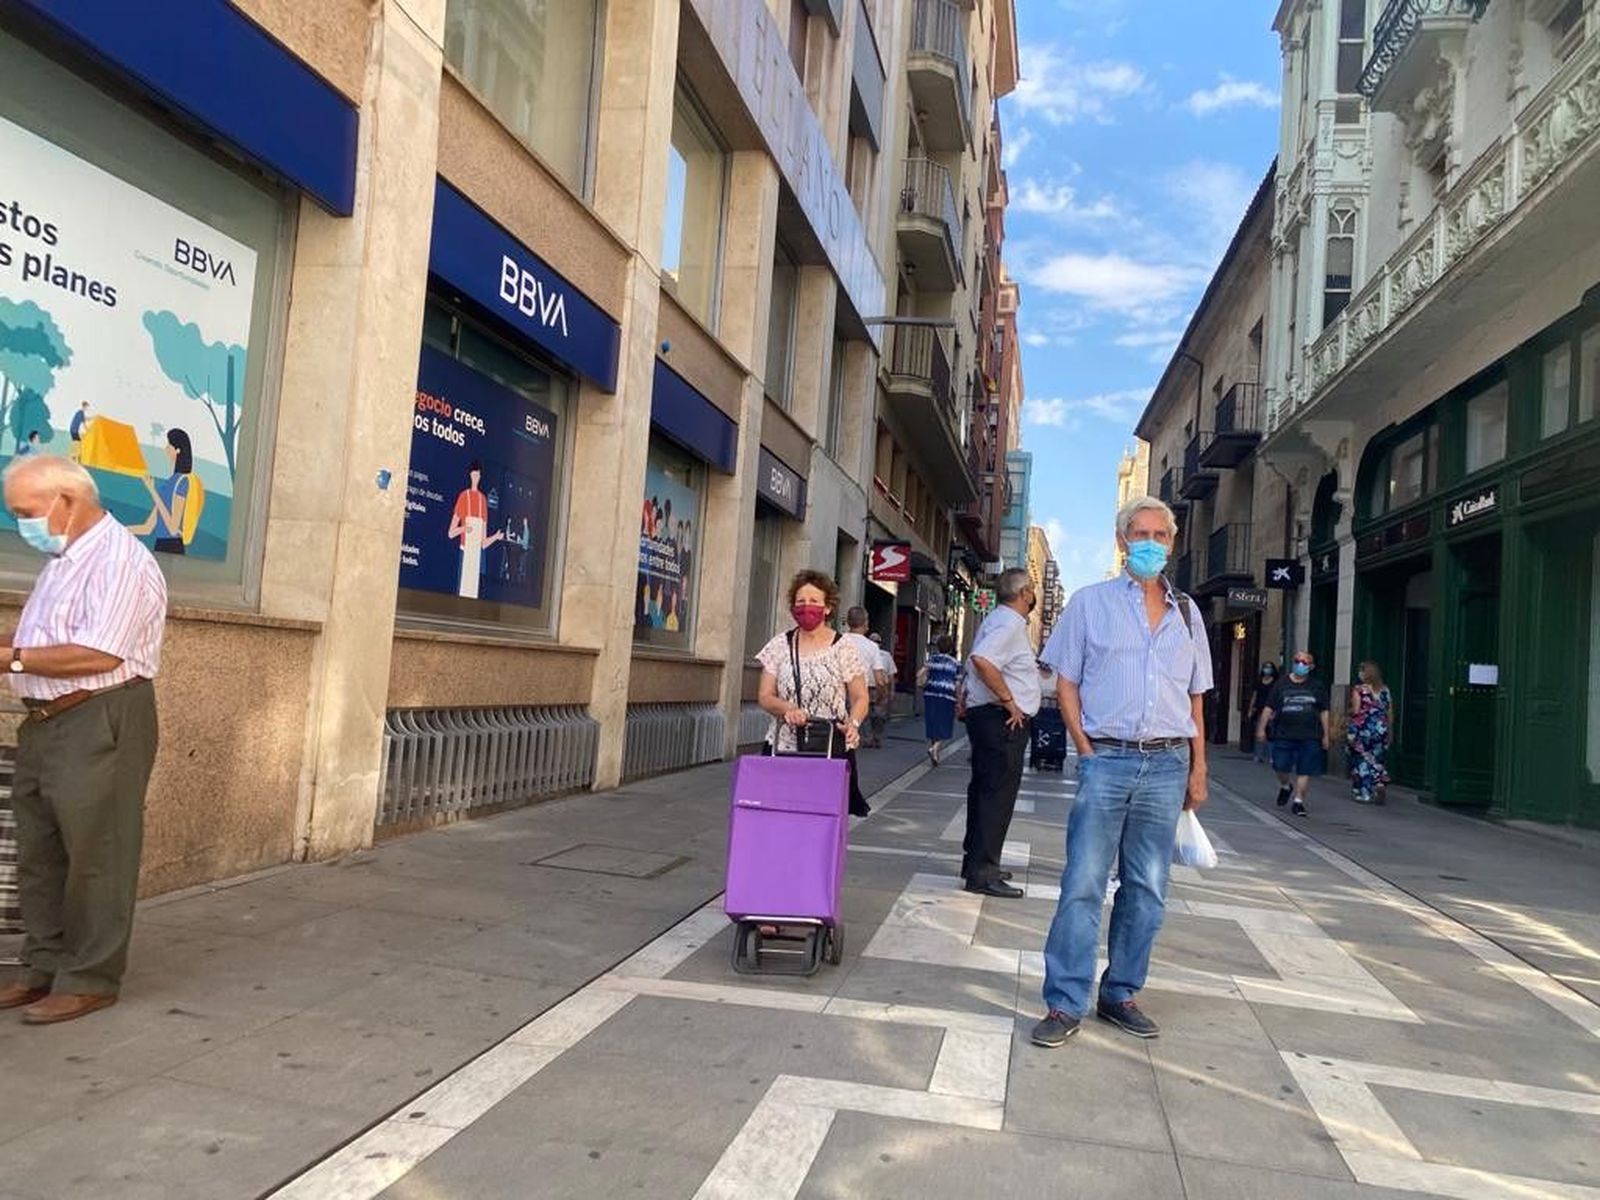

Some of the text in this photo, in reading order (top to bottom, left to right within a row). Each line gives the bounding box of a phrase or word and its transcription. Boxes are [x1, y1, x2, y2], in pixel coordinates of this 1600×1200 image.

[22, 251, 117, 307] planes
[175, 238, 236, 286] BBVA
[500, 255, 568, 337] BBVA
[432, 418, 465, 446] todos
[454, 408, 485, 436] crece,
[525, 414, 550, 438] BBVA
[770, 467, 792, 501] BBVA
